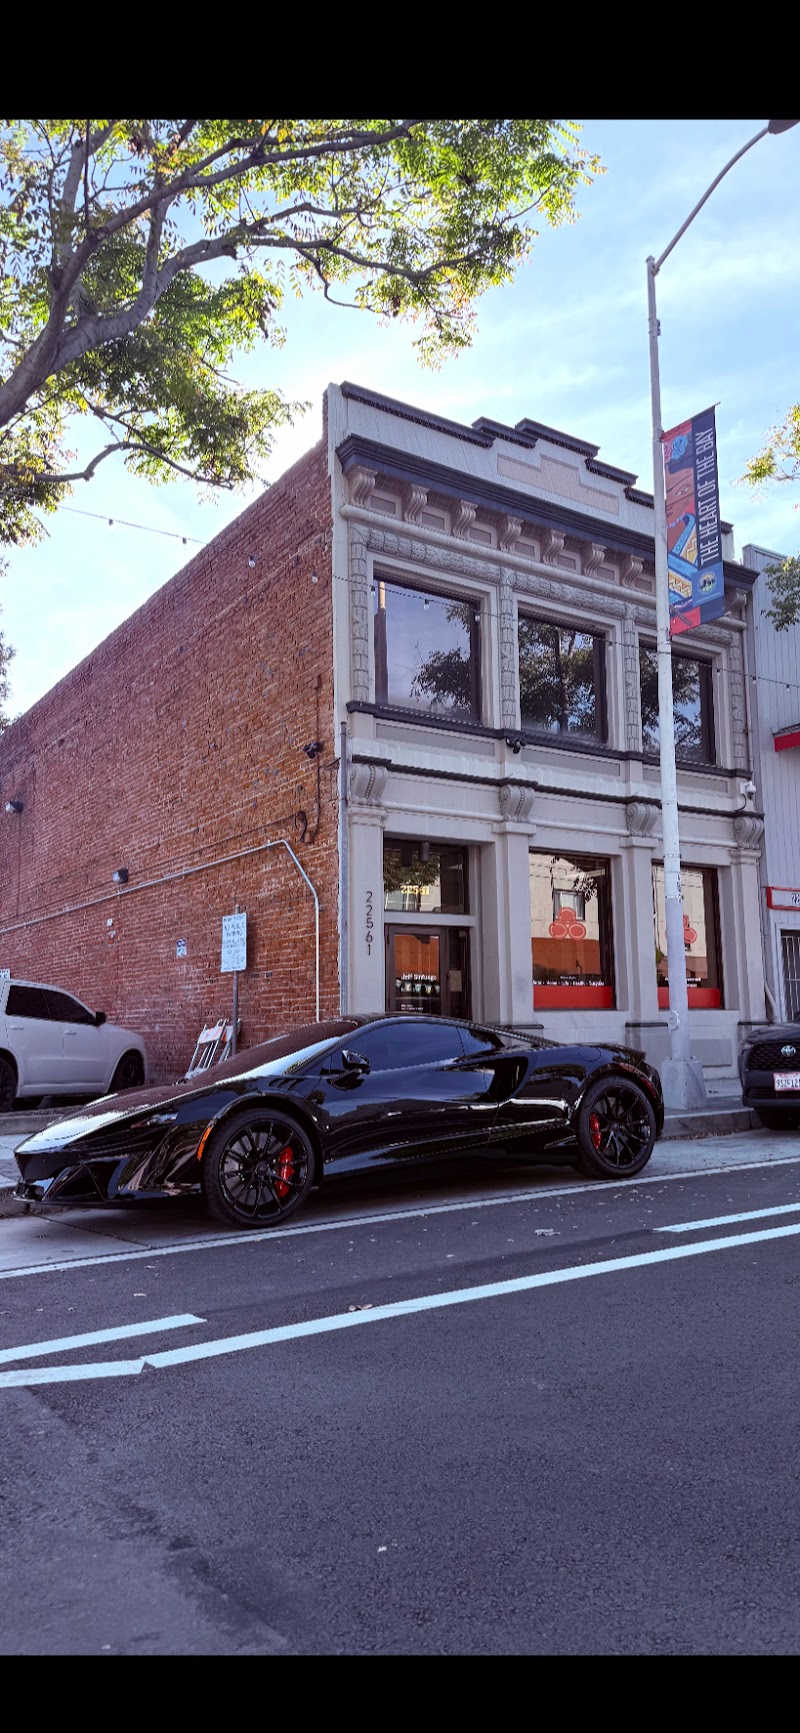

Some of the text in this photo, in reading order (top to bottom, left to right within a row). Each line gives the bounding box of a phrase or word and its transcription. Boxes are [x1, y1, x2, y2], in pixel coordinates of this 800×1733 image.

[694, 427, 719, 566] THE HEART OF THE BAY
[366, 890, 374, 956] 22561
